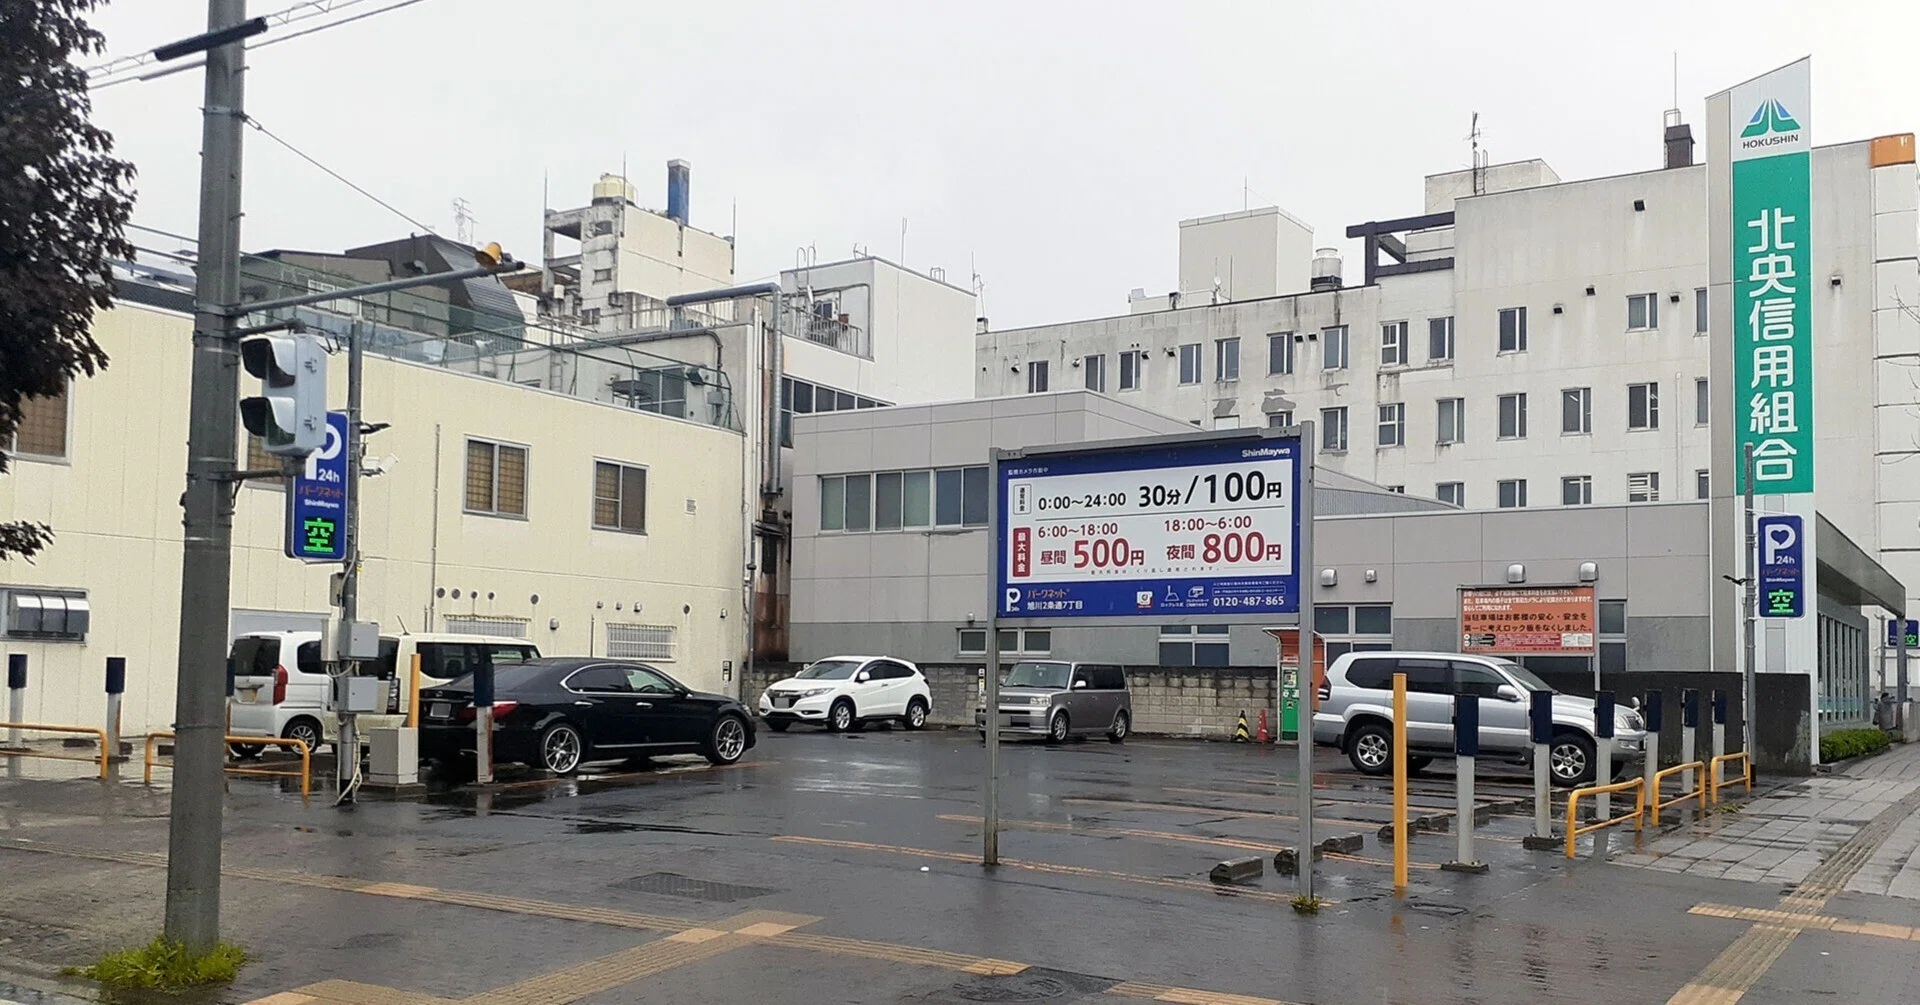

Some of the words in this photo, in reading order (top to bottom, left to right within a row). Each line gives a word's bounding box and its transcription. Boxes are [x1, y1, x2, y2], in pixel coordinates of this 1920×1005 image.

[1742, 134, 1799, 149] HOKUSHIN
[1747, 207, 1799, 482] 北央信用組合
[1241, 447, 1290, 458] ShinMaywa
[318, 468, 340, 482] 24h
[303, 517, 335, 553] 空
[1017, 532, 1027, 573] 最大料金
[1040, 550, 1067, 565] 昼間
[1073, 538, 1145, 569] 500円
[1166, 544, 1195, 561] 夜間
[1202, 531, 1282, 564] 800円
[1775, 555, 1796, 565] 24h
[1027, 589, 1067, 599] パークネット
[1212, 595, 1285, 607] 0120-487-865
[1768, 588, 1795, 614] 空
[1464, 624, 1592, 632] 第一に考えロック板をなくしました。
